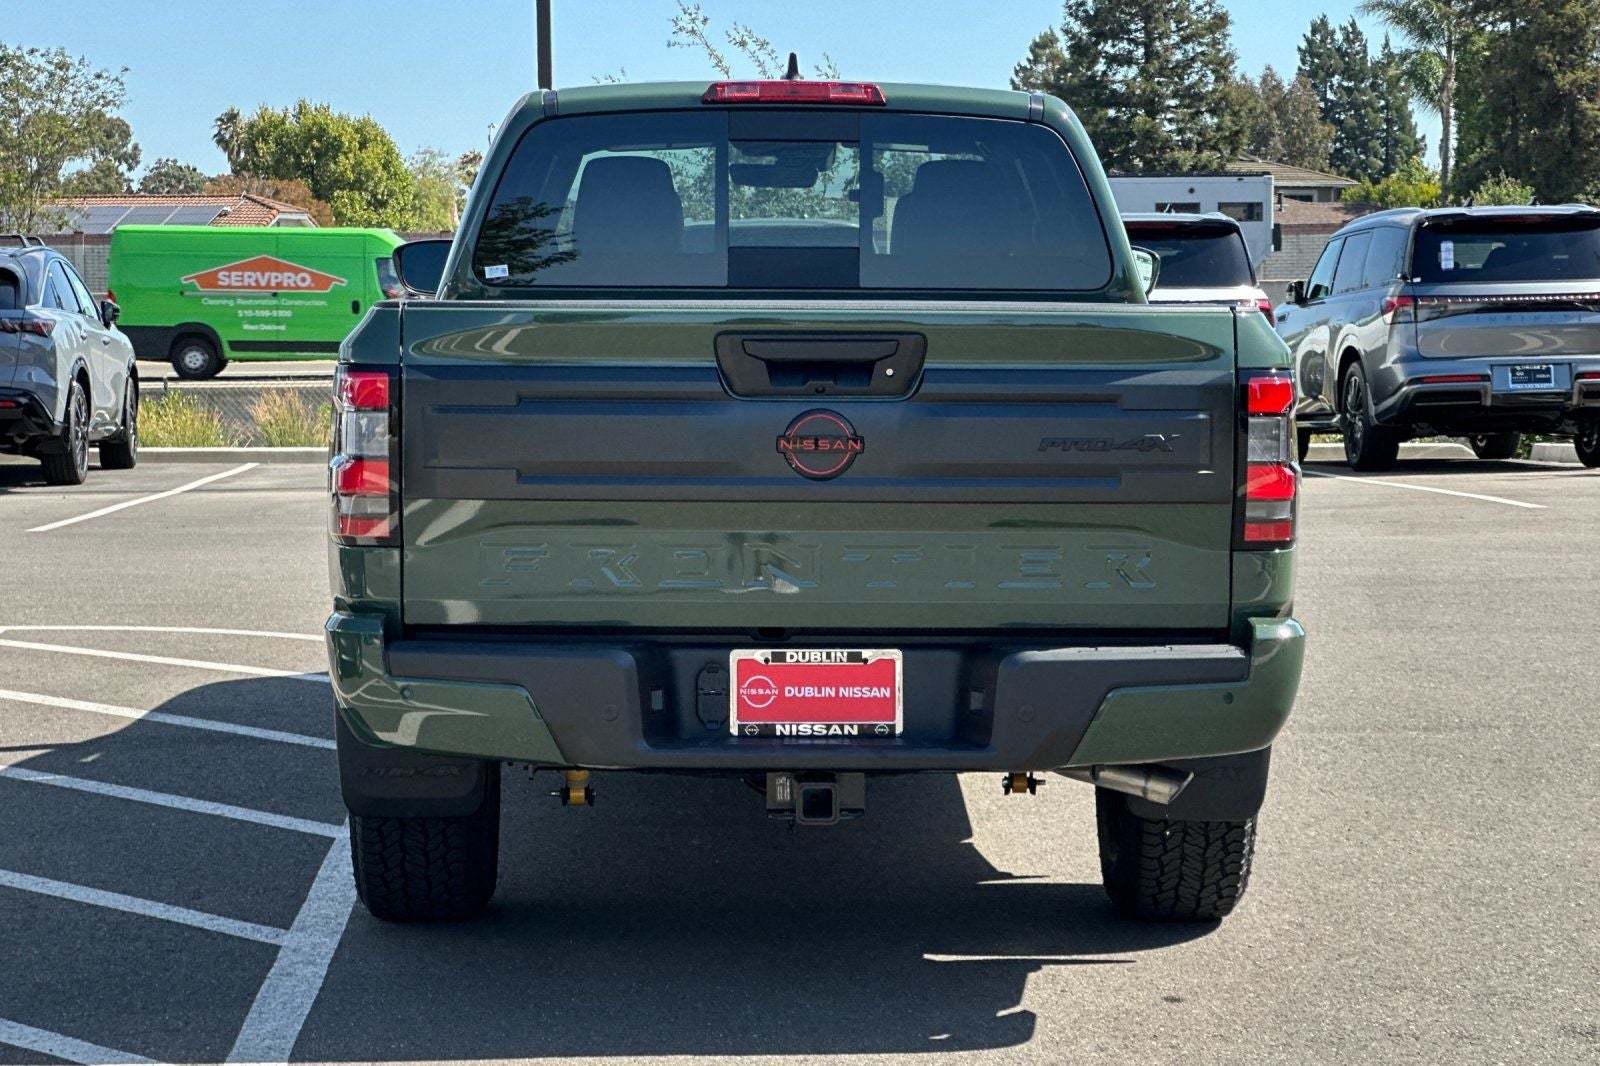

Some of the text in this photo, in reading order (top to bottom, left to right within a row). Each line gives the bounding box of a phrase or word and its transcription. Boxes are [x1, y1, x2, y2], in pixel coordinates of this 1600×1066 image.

[217, 271, 312, 288] SERVPRO
[780, 439, 861, 450] NISSAN
[1038, 434, 1182, 452] PRO-4X
[479, 543, 1156, 588] FRONTIER
[786, 651, 848, 663] DUBLIN
[740, 688, 779, 696] NISSAN
[785, 686, 891, 698] DUBLIN NISSAN
[775, 724, 859, 736] NISSAN
